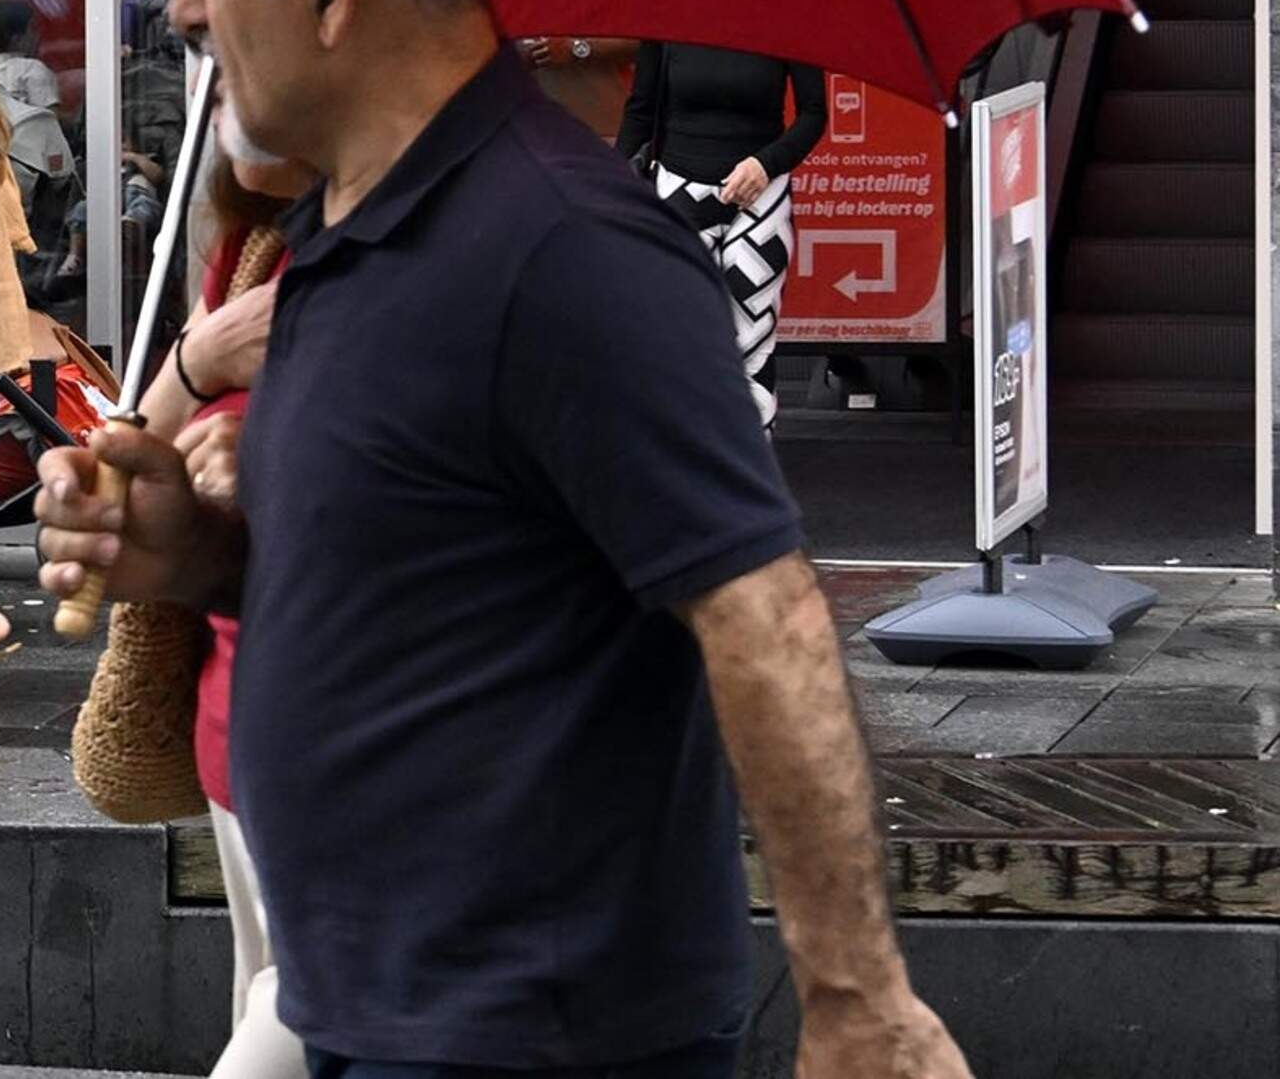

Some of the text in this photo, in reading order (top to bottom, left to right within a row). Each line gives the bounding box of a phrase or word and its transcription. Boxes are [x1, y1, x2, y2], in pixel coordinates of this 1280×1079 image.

[842, 152, 928, 169] ontvangen?
[809, 172, 829, 195] je
[832, 172, 931, 196] bestelling
[814, 201, 836, 217] bij
[836, 200, 855, 215] de
[857, 200, 912, 215] lockers
[914, 204, 934, 217] op
